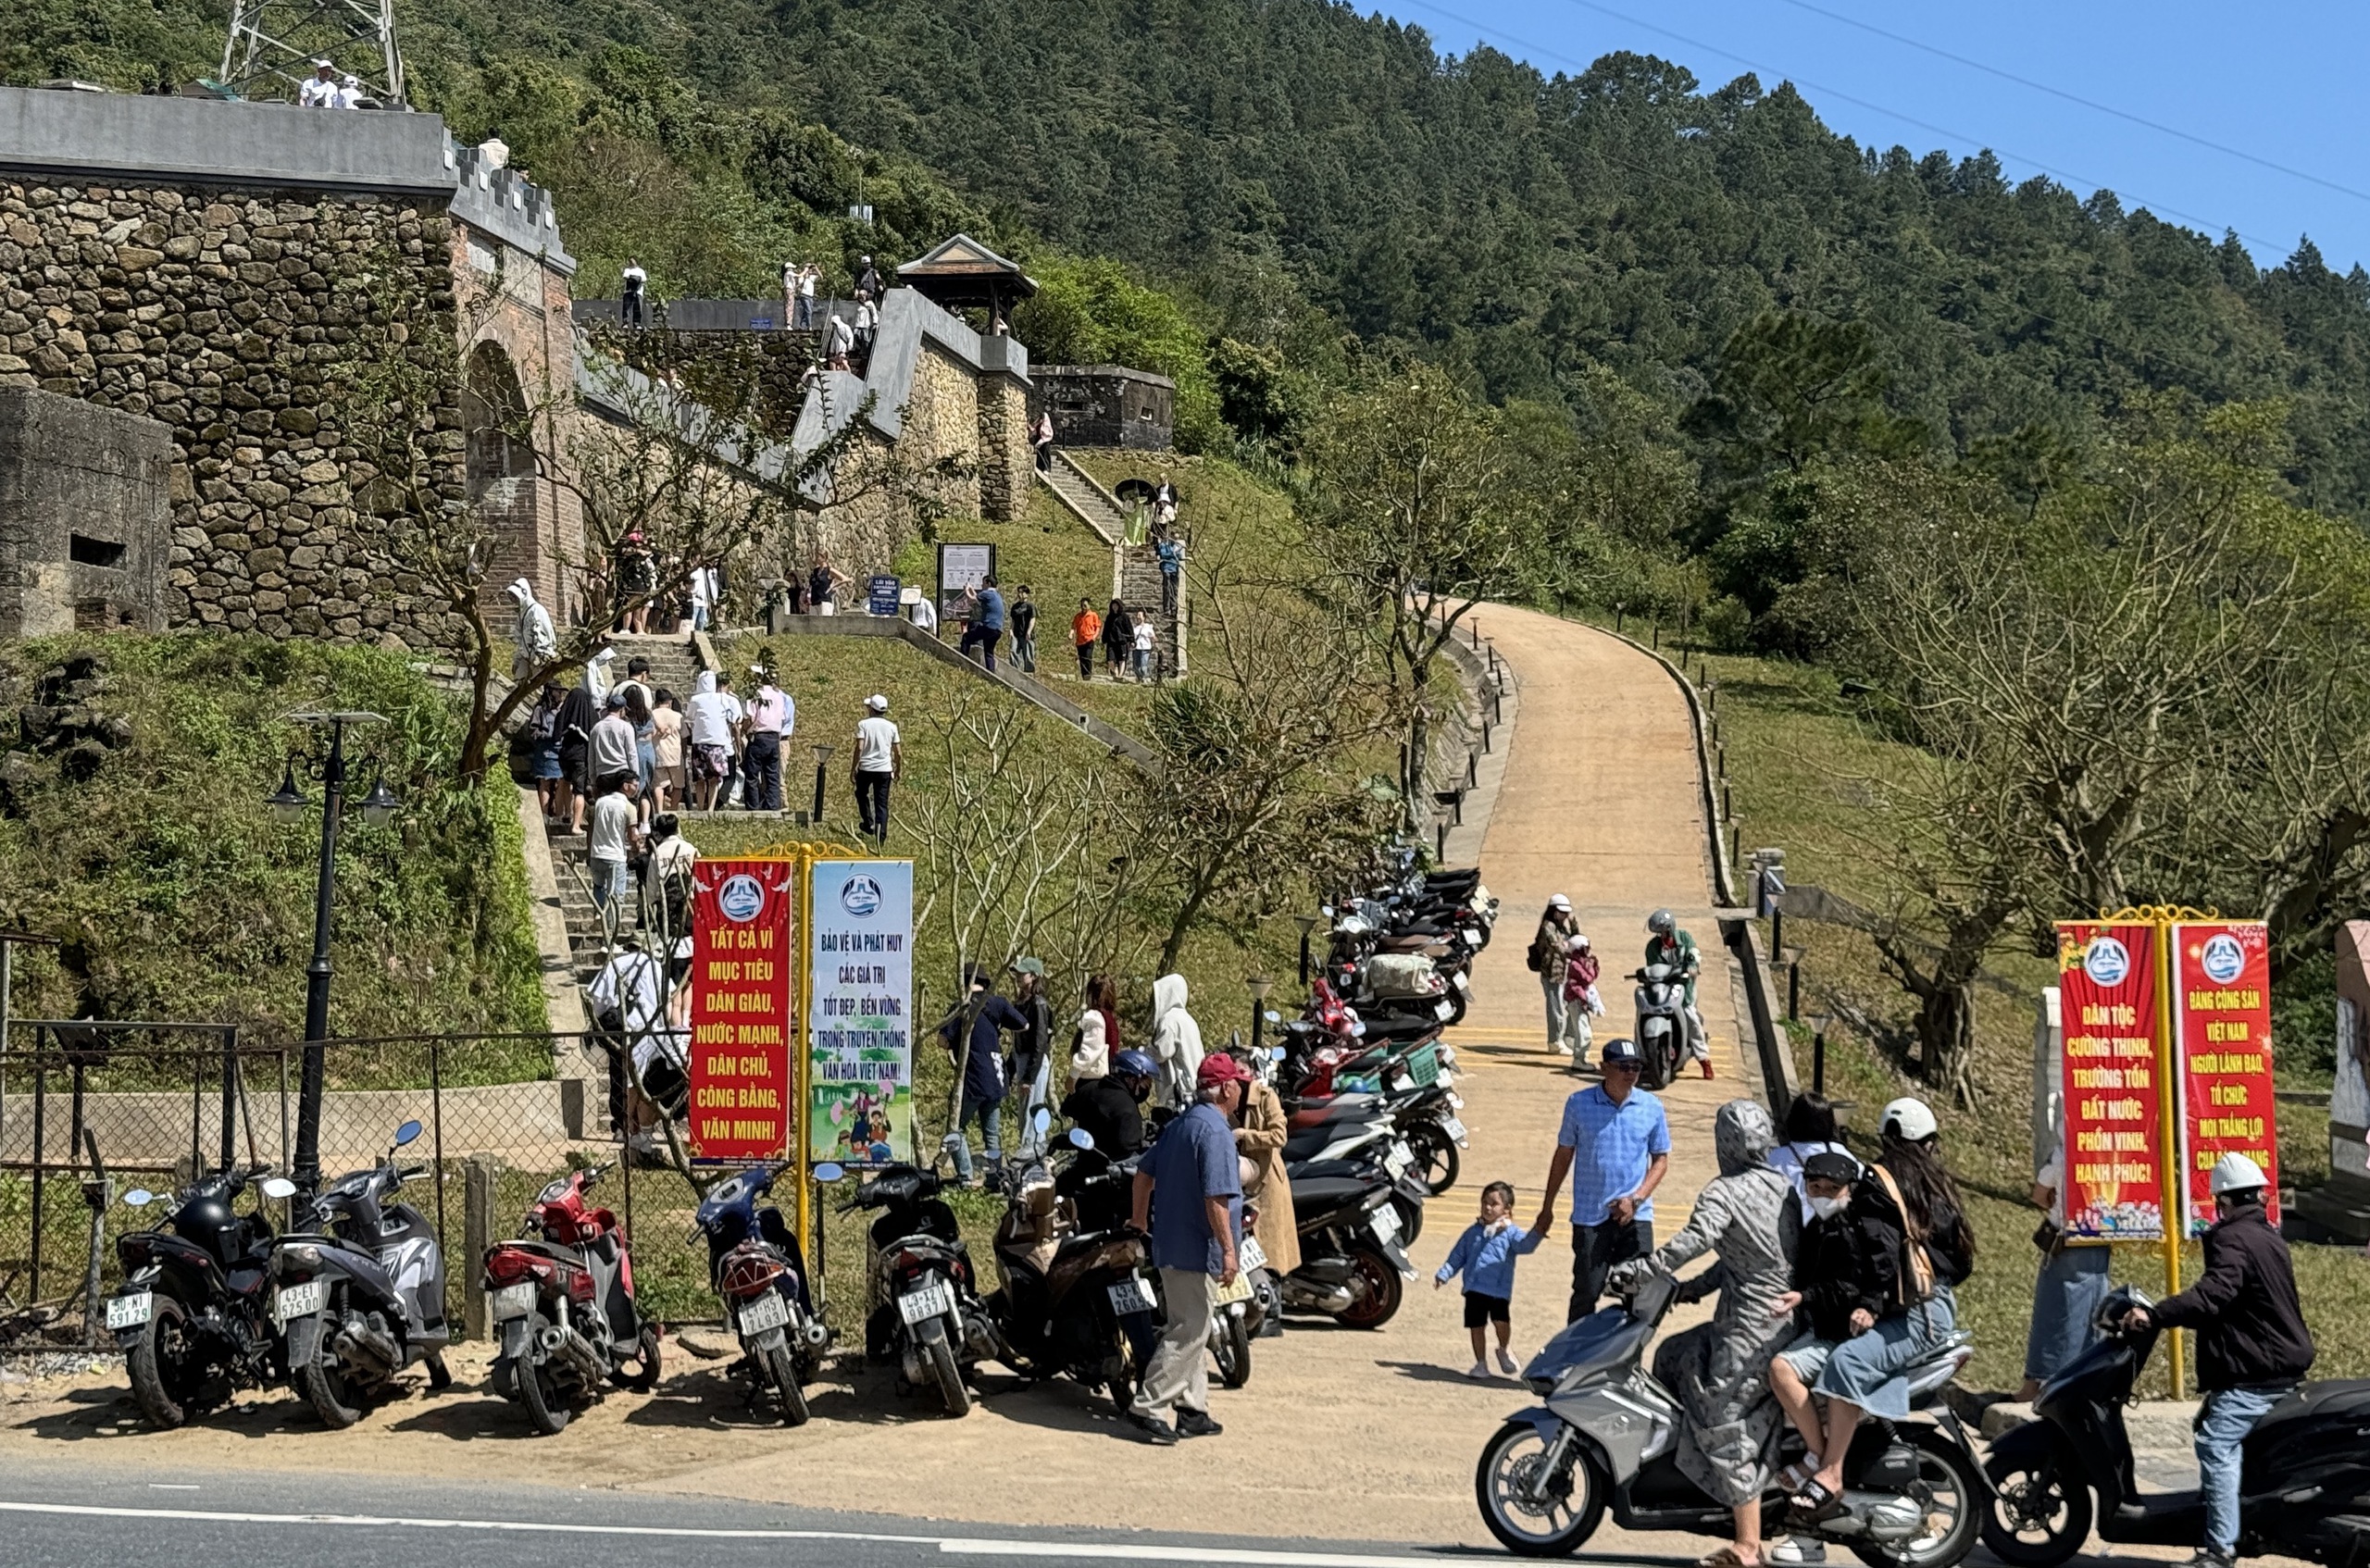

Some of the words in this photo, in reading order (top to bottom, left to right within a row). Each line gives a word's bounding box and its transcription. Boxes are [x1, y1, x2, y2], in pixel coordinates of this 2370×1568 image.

[709, 923, 734, 950] TẤT
[738, 924, 756, 950] CẢ
[760, 926, 774, 950] VÌ
[821, 927, 838, 952] BẢO
[840, 929, 850, 957] VỆ
[852, 929, 862, 952] VÀ
[865, 929, 885, 952] PHÁT
[887, 934, 904, 952] HUY
[708, 962, 740, 985] MỤC
[744, 957, 774, 981] TIÊU
[839, 962, 855, 985] CÁC
[857, 962, 871, 984] GIÁ
[873, 965, 886, 989] TRỊ
[705, 989, 735, 1013] DÂN
[739, 989, 775, 1015] GIÀU,
[823, 991, 838, 1016] TỐT
[840, 998, 856, 1021] ĐẸP,
[2189, 985, 2214, 1011] ĐẢNG
[2215, 986, 2240, 1014] CỘNG
[2241, 984, 2261, 1010] SẢN
[2082, 1002, 2110, 1027] DÂN
[2111, 1002, 2137, 1029] TỘC
[696, 1021, 734, 1045] NƯỚC
[738, 1025, 784, 1049] MẠNH,
[818, 1029, 844, 1048] TRONG
[879, 1024, 905, 1048] THỐNG
[2066, 1032, 2111, 1058] CƯỜNG
[2206, 1018, 2226, 1046] VIỆT
[2227, 1022, 2249, 1042] NAM
[707, 1052, 736, 1076] DÂN
[740, 1051, 772, 1079] CHỦ,
[823, 1058, 840, 1081] VĂN
[841, 1058, 857, 1081] HÓA
[859, 1058, 877, 1084] VIỆT
[879, 1063, 901, 1081] NAM!
[2189, 1050, 2217, 1075] NGƯỜI
[2218, 1051, 2243, 1074] LÃNH
[2072, 1064, 2124, 1089] TRƯỜNG
[697, 1084, 735, 1108] CÔNG
[739, 1080, 781, 1112] BẰNG,
[2081, 1093, 2106, 1120] ĐẤT
[2108, 1096, 2144, 1121] NƯỚC
[2223, 1081, 2248, 1106] CHỨC
[702, 1115, 730, 1139] VĂN
[733, 1120, 776, 1140] MINH!
[2199, 1118, 2217, 1141] MỌI
[2218, 1111, 2248, 1138] THẮNG
[2075, 1163, 2111, 1188] HẠNH
[2113, 1159, 2152, 1184] PHÚC!
[285, 1284, 313, 1302] 43-E1
[908, 1300, 939, 1321] 9837
